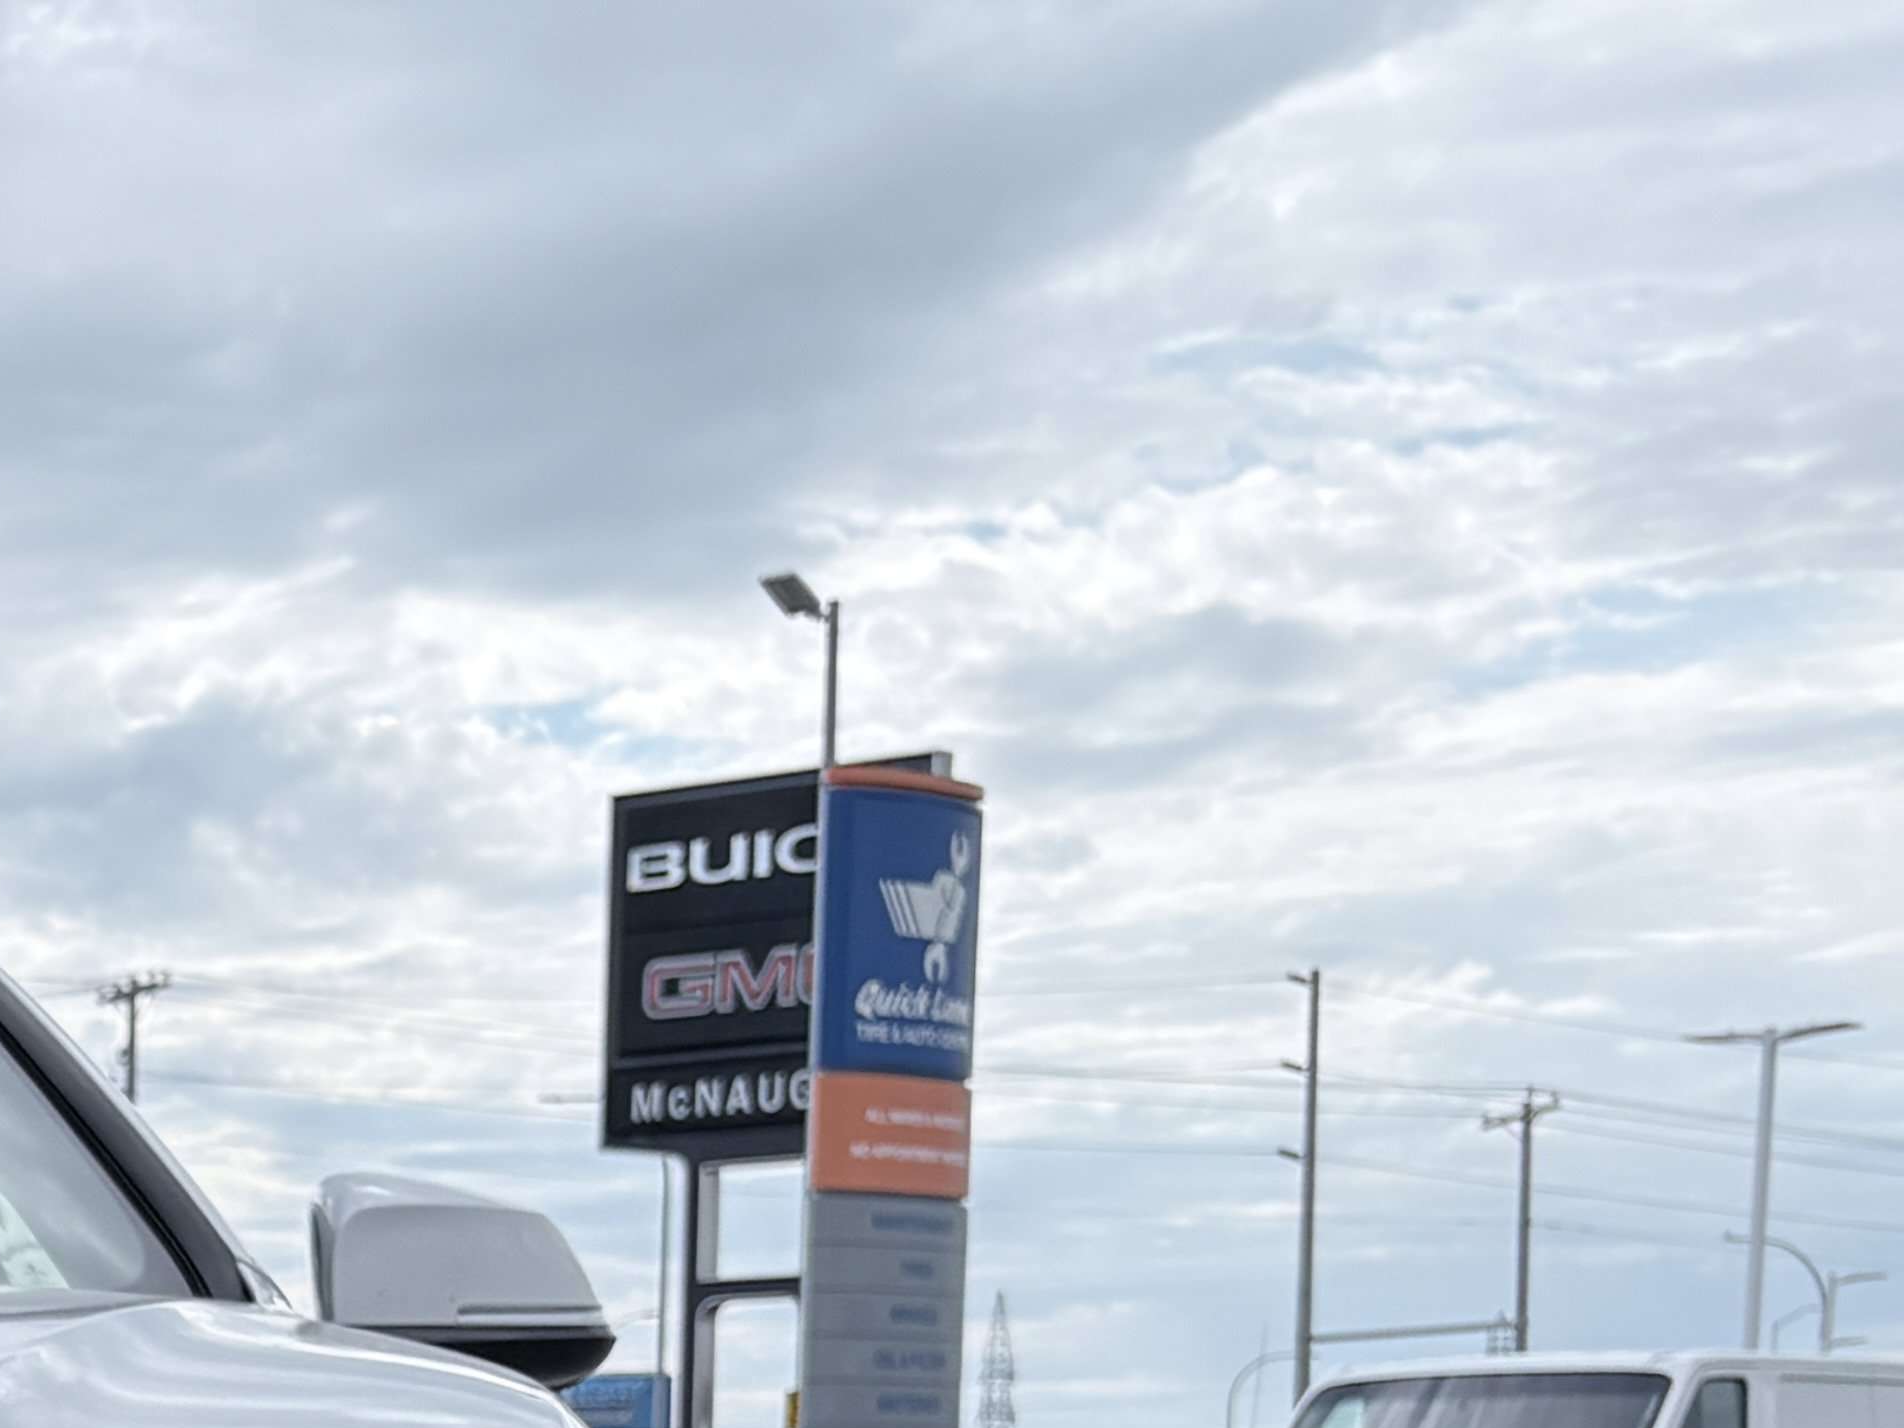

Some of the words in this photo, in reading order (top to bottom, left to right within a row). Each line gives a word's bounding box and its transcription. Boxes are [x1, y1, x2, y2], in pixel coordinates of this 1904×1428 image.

[625, 822, 819, 895] BUIC
[855, 980, 929, 1020] Quick
[629, 1068, 810, 1125] McNAUG
